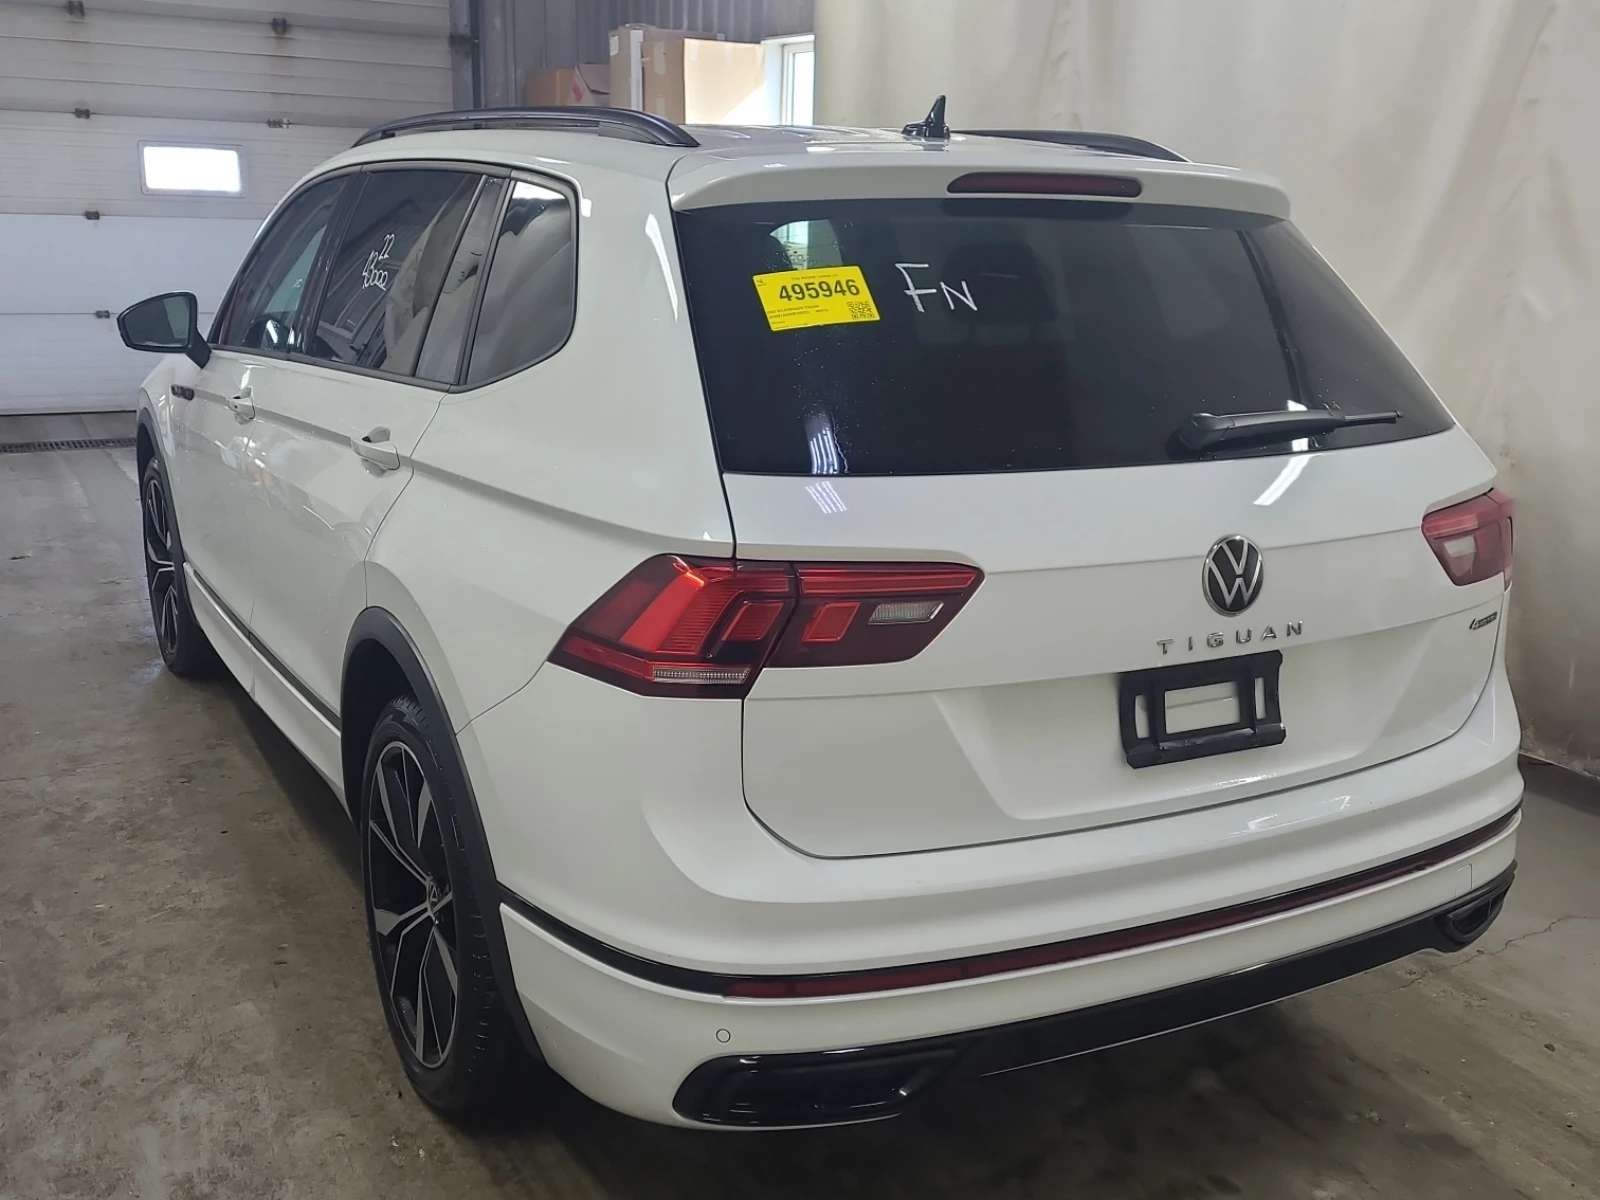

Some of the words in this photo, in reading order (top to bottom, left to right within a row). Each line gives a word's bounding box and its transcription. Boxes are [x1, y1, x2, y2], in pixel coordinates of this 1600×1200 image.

[378, 233, 396, 261] 22
[779, 278, 861, 302] 495946
[894, 262, 978, 313] FN
[1156, 620, 1304, 655] TIGUAN
